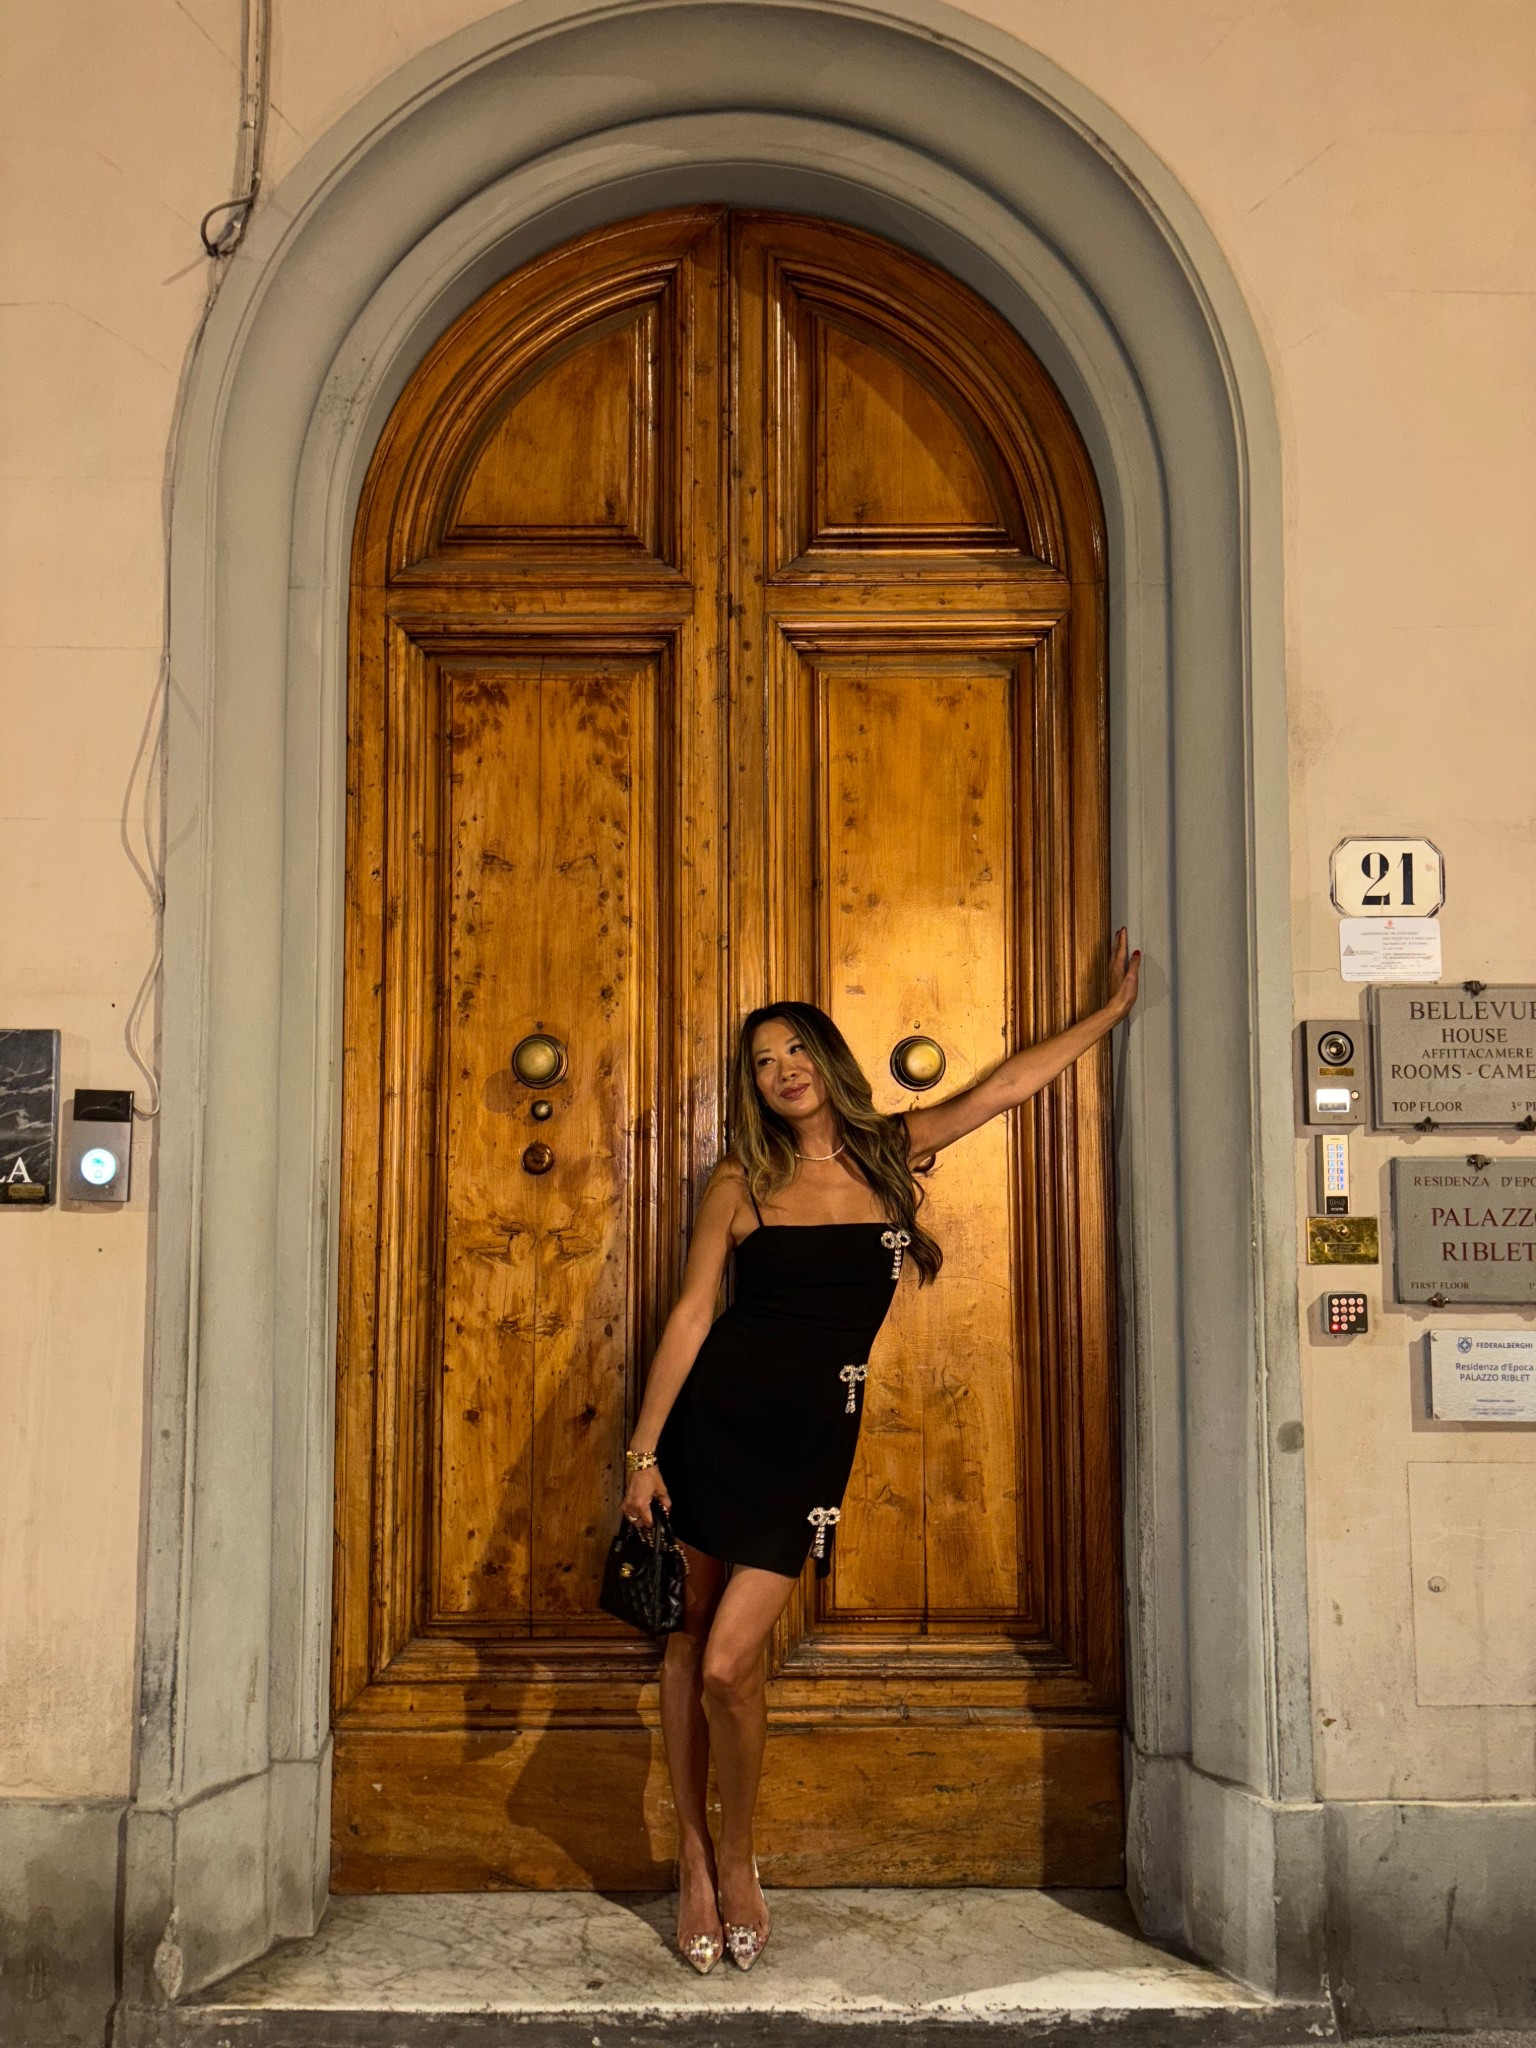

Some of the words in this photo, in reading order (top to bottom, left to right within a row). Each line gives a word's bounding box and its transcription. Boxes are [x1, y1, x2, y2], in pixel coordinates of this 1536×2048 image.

[1361, 851, 1416, 906] 21
[1441, 1028, 1508, 1043] HOUSE
[1421, 1048, 1534, 1059] AFFITTACAMERE
[1391, 1064, 1462, 1079] ROOMS
[1392, 1101, 1417, 1112] TOP
[1420, 1101, 1463, 1112] FLOOR
[1414, 1176, 1490, 1187] RESIDENZA
[1431, 1207, 1536, 1227] PALAZZ
[1442, 1242, 1536, 1262] RIBLET
[1440, 1282, 1470, 1290] FLOOR
[1455, 1362, 1499, 1371] Residenza
[1460, 1374, 1499, 1382] PALAZZO
[1501, 1374, 1531, 1382] RIBLET
